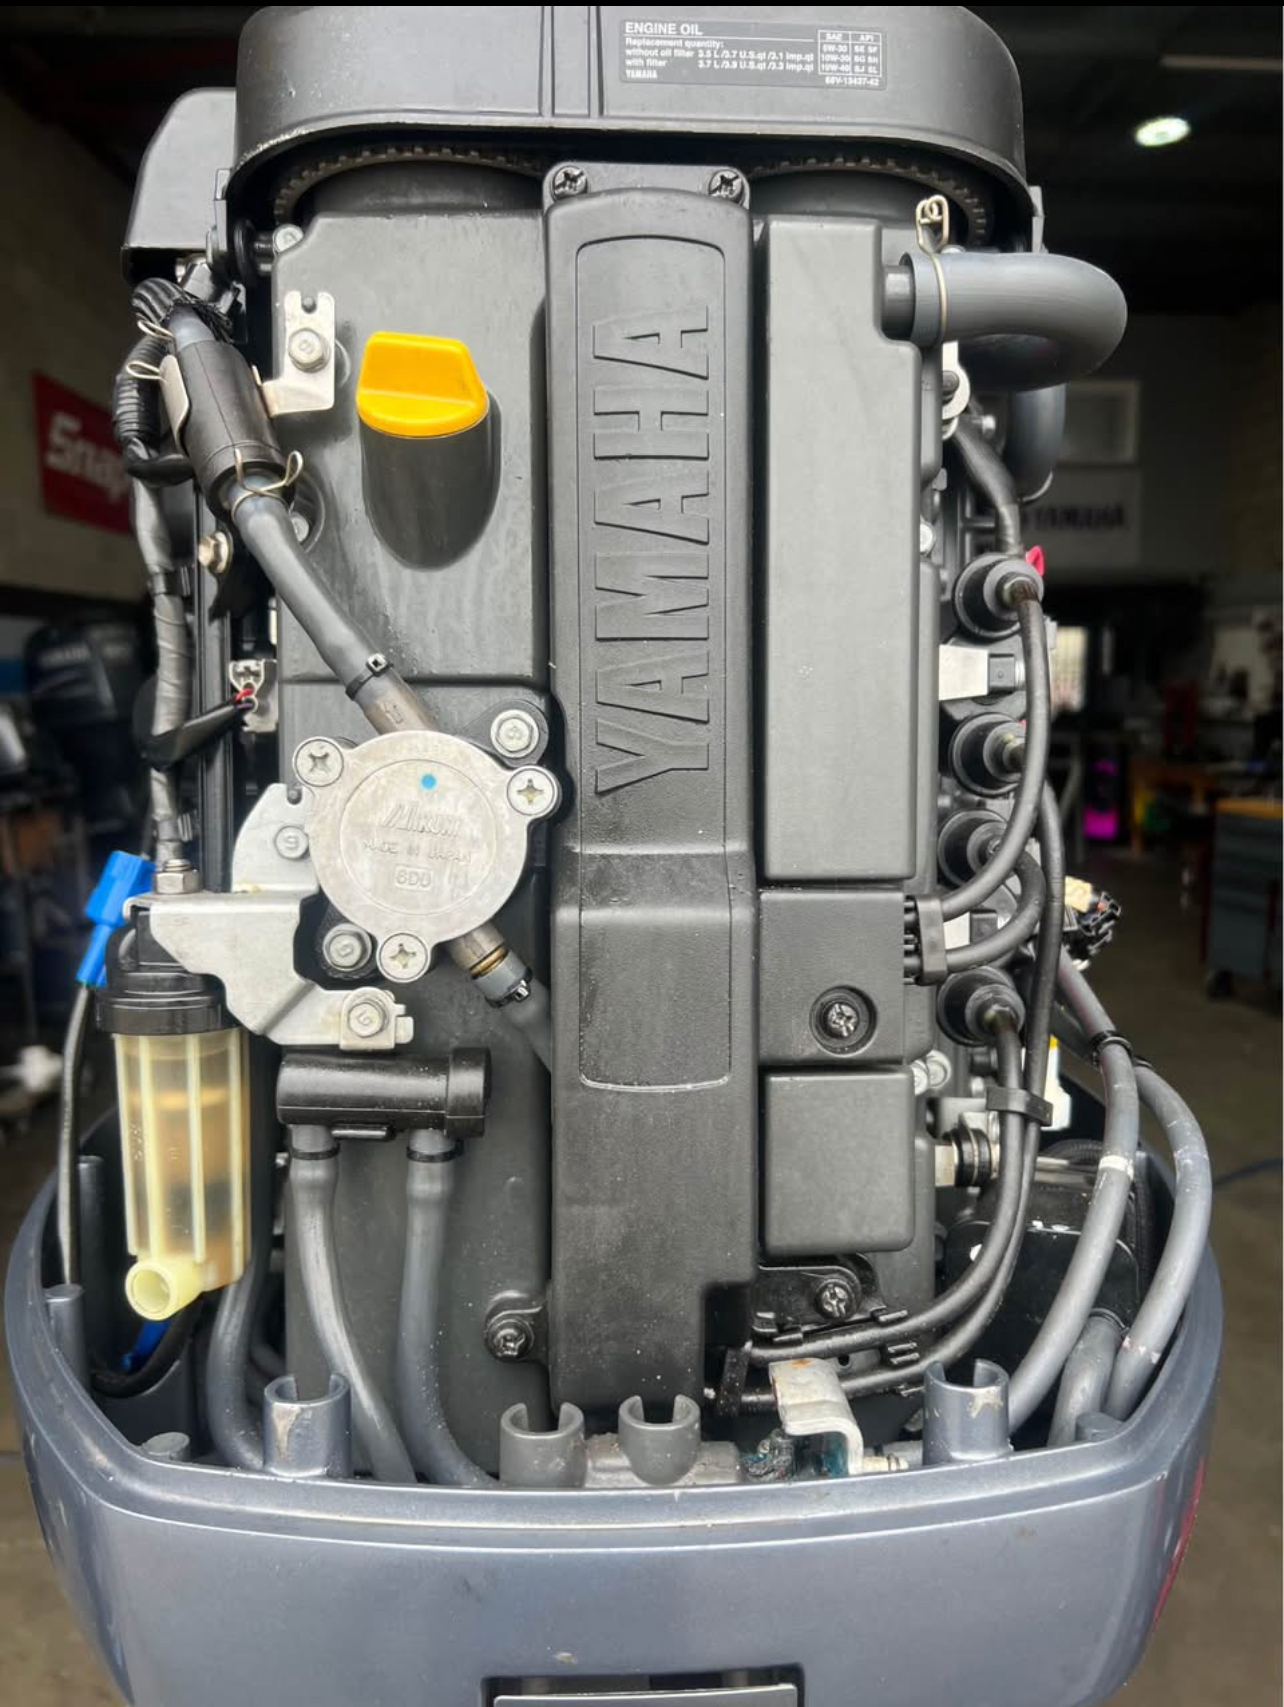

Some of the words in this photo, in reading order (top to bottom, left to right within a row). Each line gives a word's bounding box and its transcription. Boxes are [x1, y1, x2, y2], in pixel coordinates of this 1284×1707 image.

[625, 21, 677, 35] ENGINE
[680, 23, 704, 36] OIL
[826, 33, 843, 41] SAE
[859, 34, 874, 42] API
[625, 37, 683, 48] Replacement
[684, 39, 724, 50] quantity:
[625, 47, 658, 57] without
[660, 48, 672, 57] oil
[674, 49, 694, 58] filter
[822, 44, 848, 53] 5W-30
[821, 53, 851, 62] 10W-30
[625, 58, 644, 67] with
[646, 58, 667, 67] filter
[625, 69, 658, 79] YAMAHA
[594, 304, 710, 798] YAMAHA
